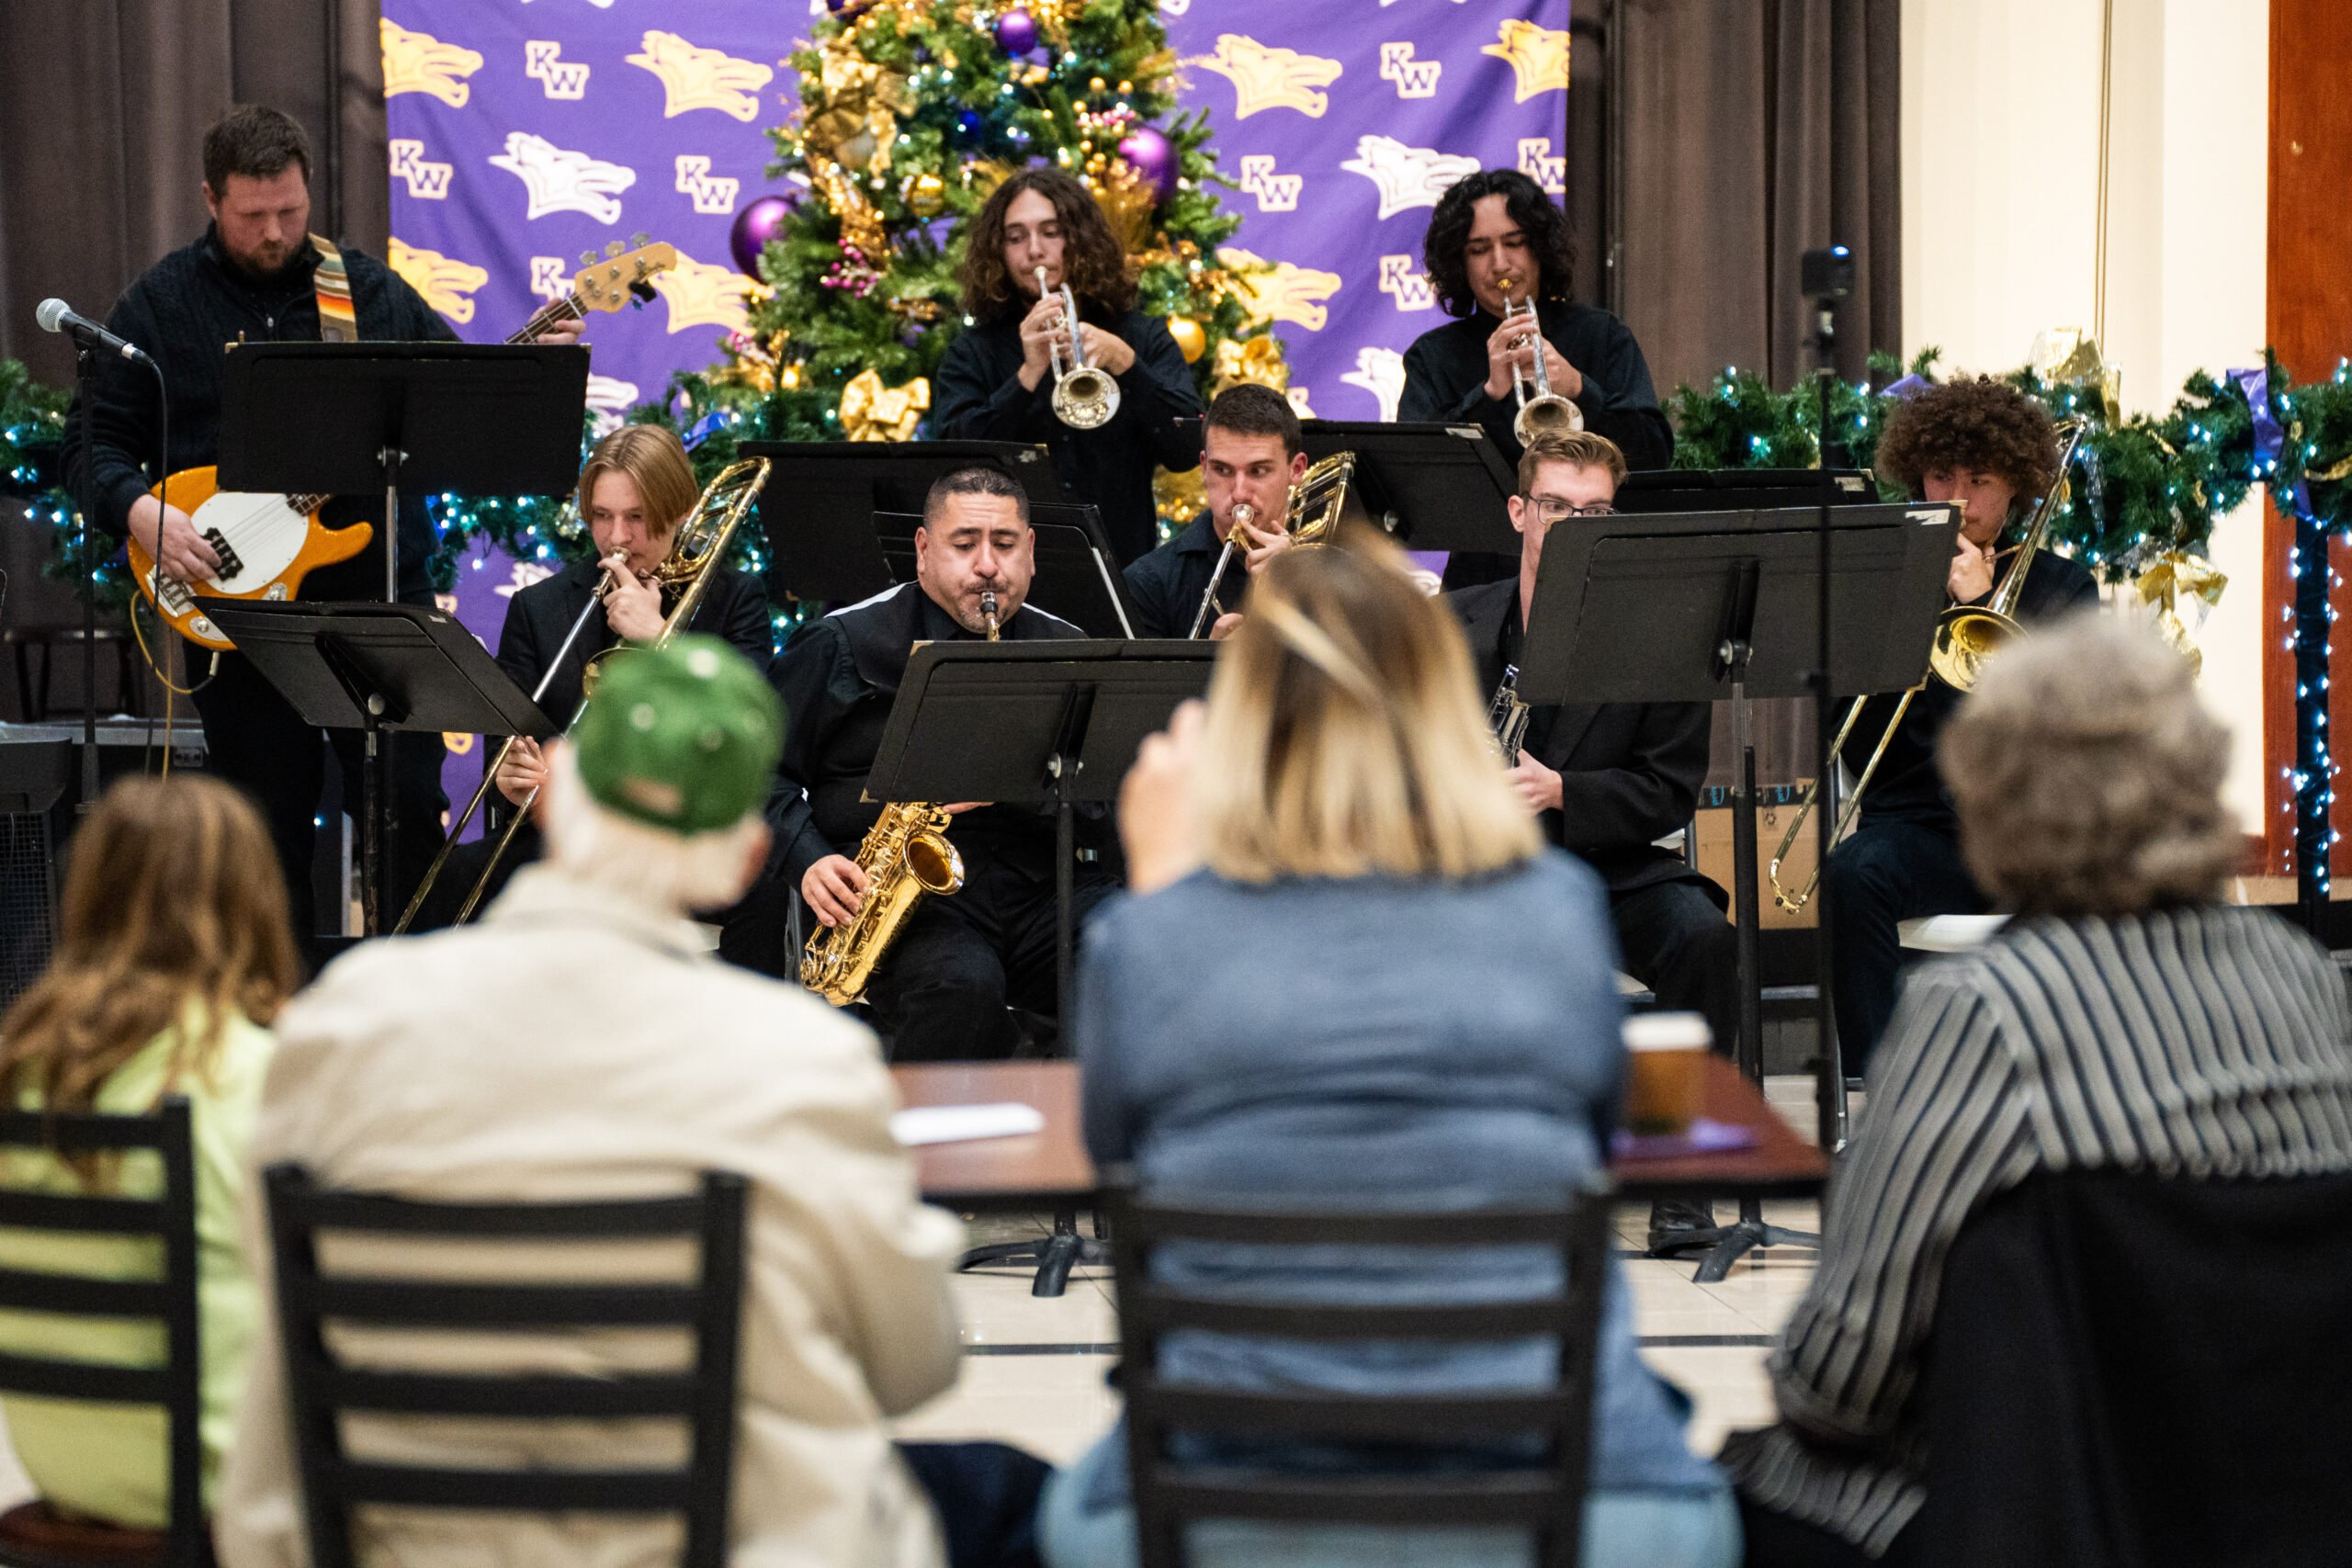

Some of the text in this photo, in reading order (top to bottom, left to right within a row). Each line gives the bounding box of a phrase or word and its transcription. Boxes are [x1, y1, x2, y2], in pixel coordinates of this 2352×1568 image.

[526, 41, 589, 98] KW
[1381, 42, 1440, 97] KW
[391, 141, 451, 197] KW
[676, 156, 738, 212] KW
[1241, 156, 1302, 210] KW
[1519, 139, 1566, 193] KW
[1380, 255, 1435, 310] KW
